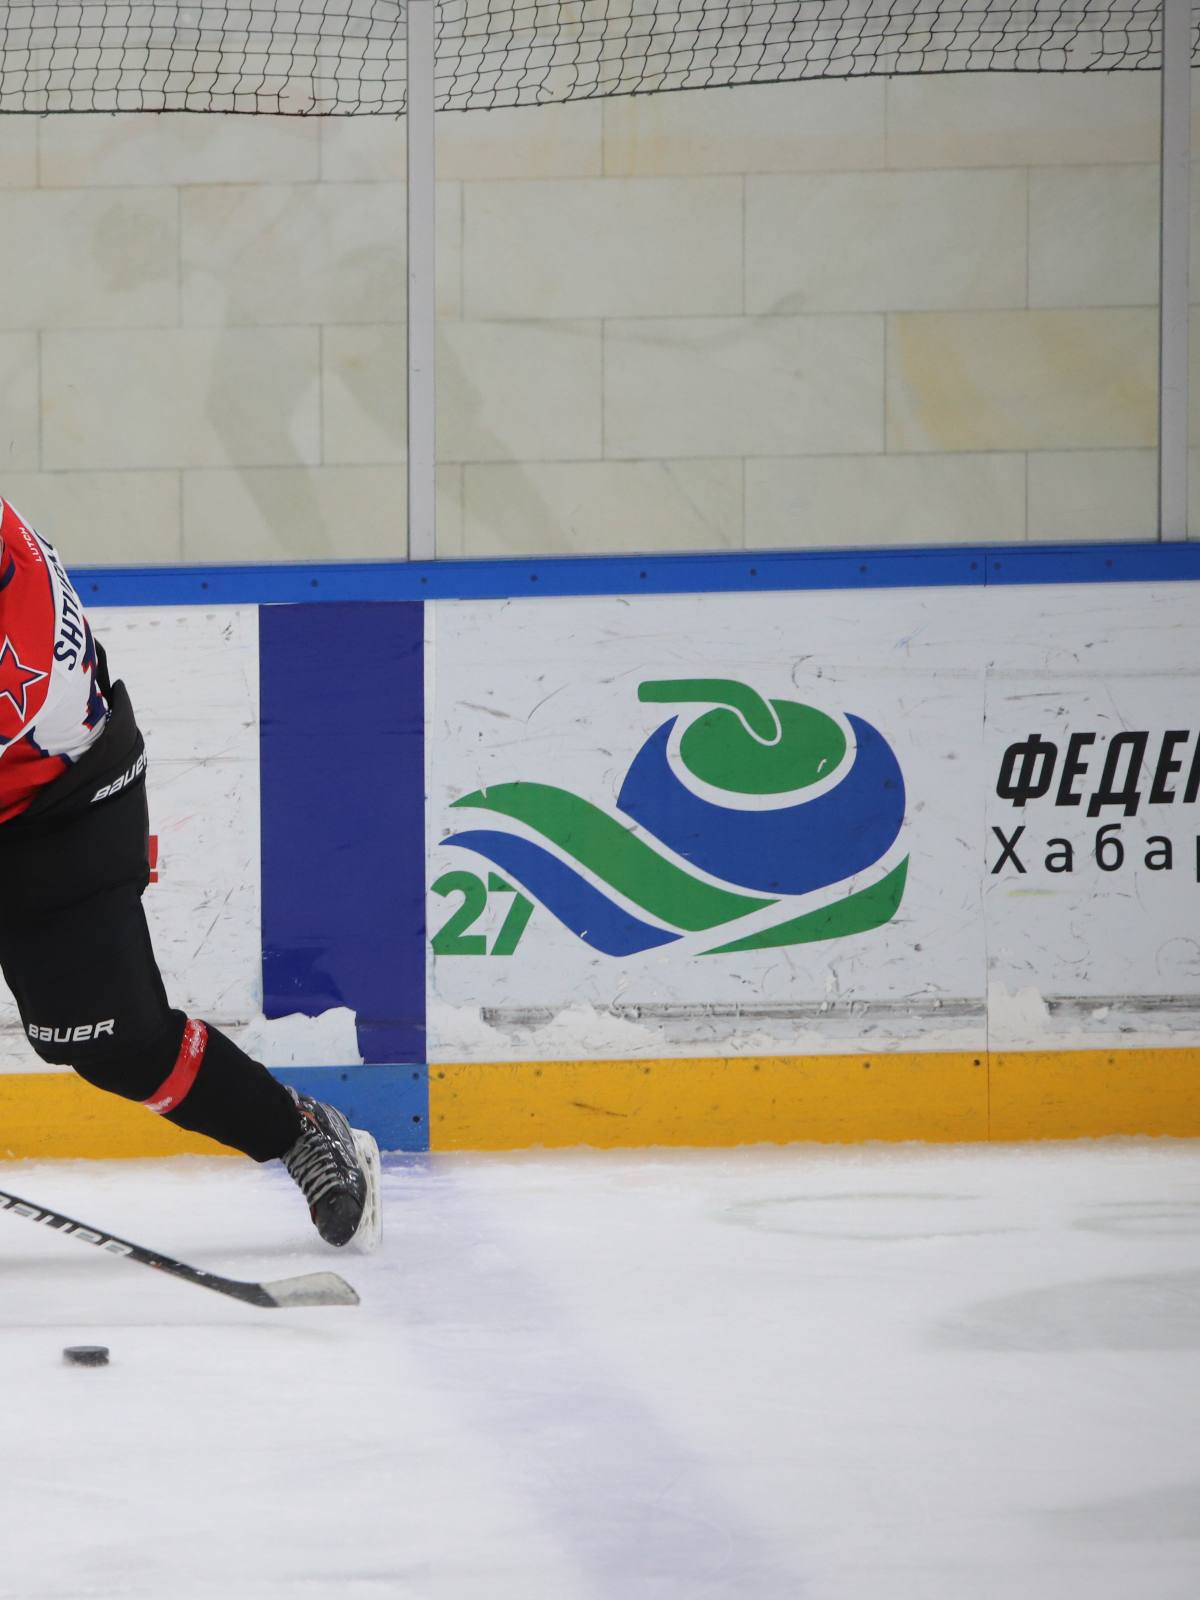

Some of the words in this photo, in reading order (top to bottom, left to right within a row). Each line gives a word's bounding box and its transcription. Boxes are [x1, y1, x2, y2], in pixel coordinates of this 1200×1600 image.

[18, 526, 42, 562] LUTCH
[995, 729, 1200, 818] ФЕДЕ
[990, 822, 1200, 883] Хаба
[429, 870, 536, 956] 27
[28, 1018, 116, 1043] BAUER
